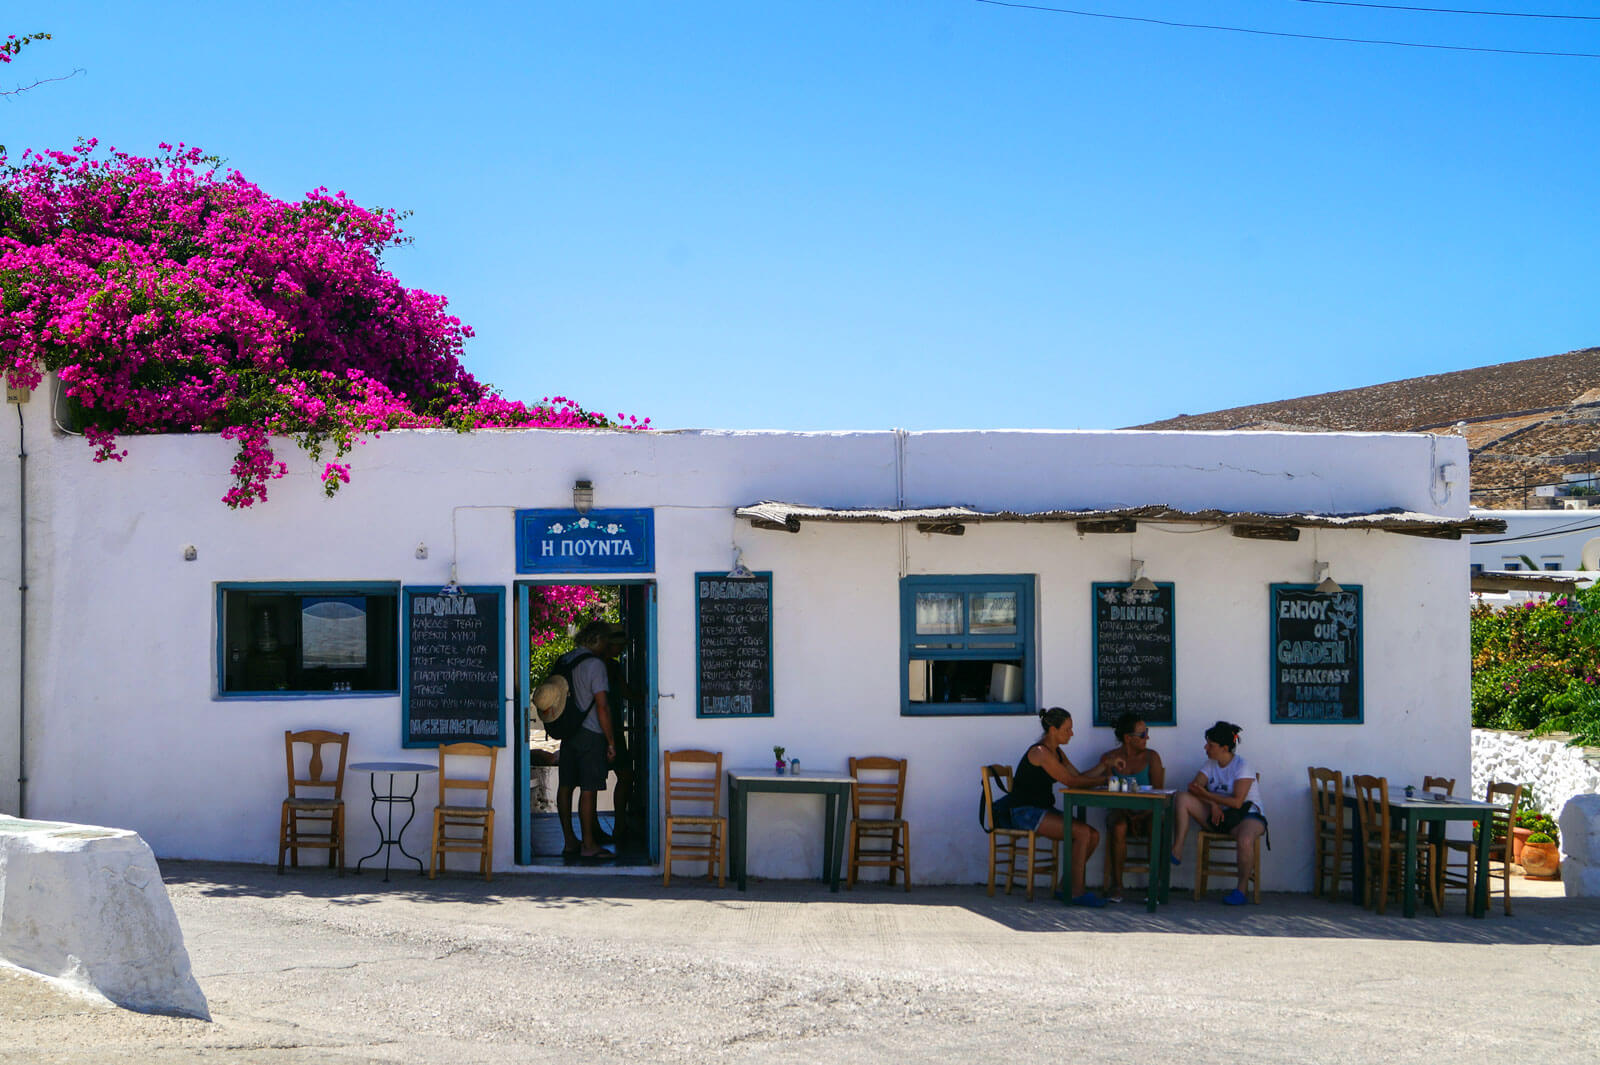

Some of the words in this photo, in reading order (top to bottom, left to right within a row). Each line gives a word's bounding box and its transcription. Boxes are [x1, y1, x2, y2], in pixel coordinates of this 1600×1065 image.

[541, 540, 554, 556] Η
[561, 539, 634, 556] ΠΟΥΝΤΑ
[1111, 606, 1164, 624] DINNER
[1280, 600, 1330, 620] ENJOY
[1314, 623, 1339, 640] OUR
[1278, 640, 1345, 664] GARDEN
[1281, 668, 1350, 684] BREAKFAST
[1295, 685, 1340, 701] LUNCH
[703, 695, 753, 713] LUNCH
[1287, 701, 1343, 719] DINNER
